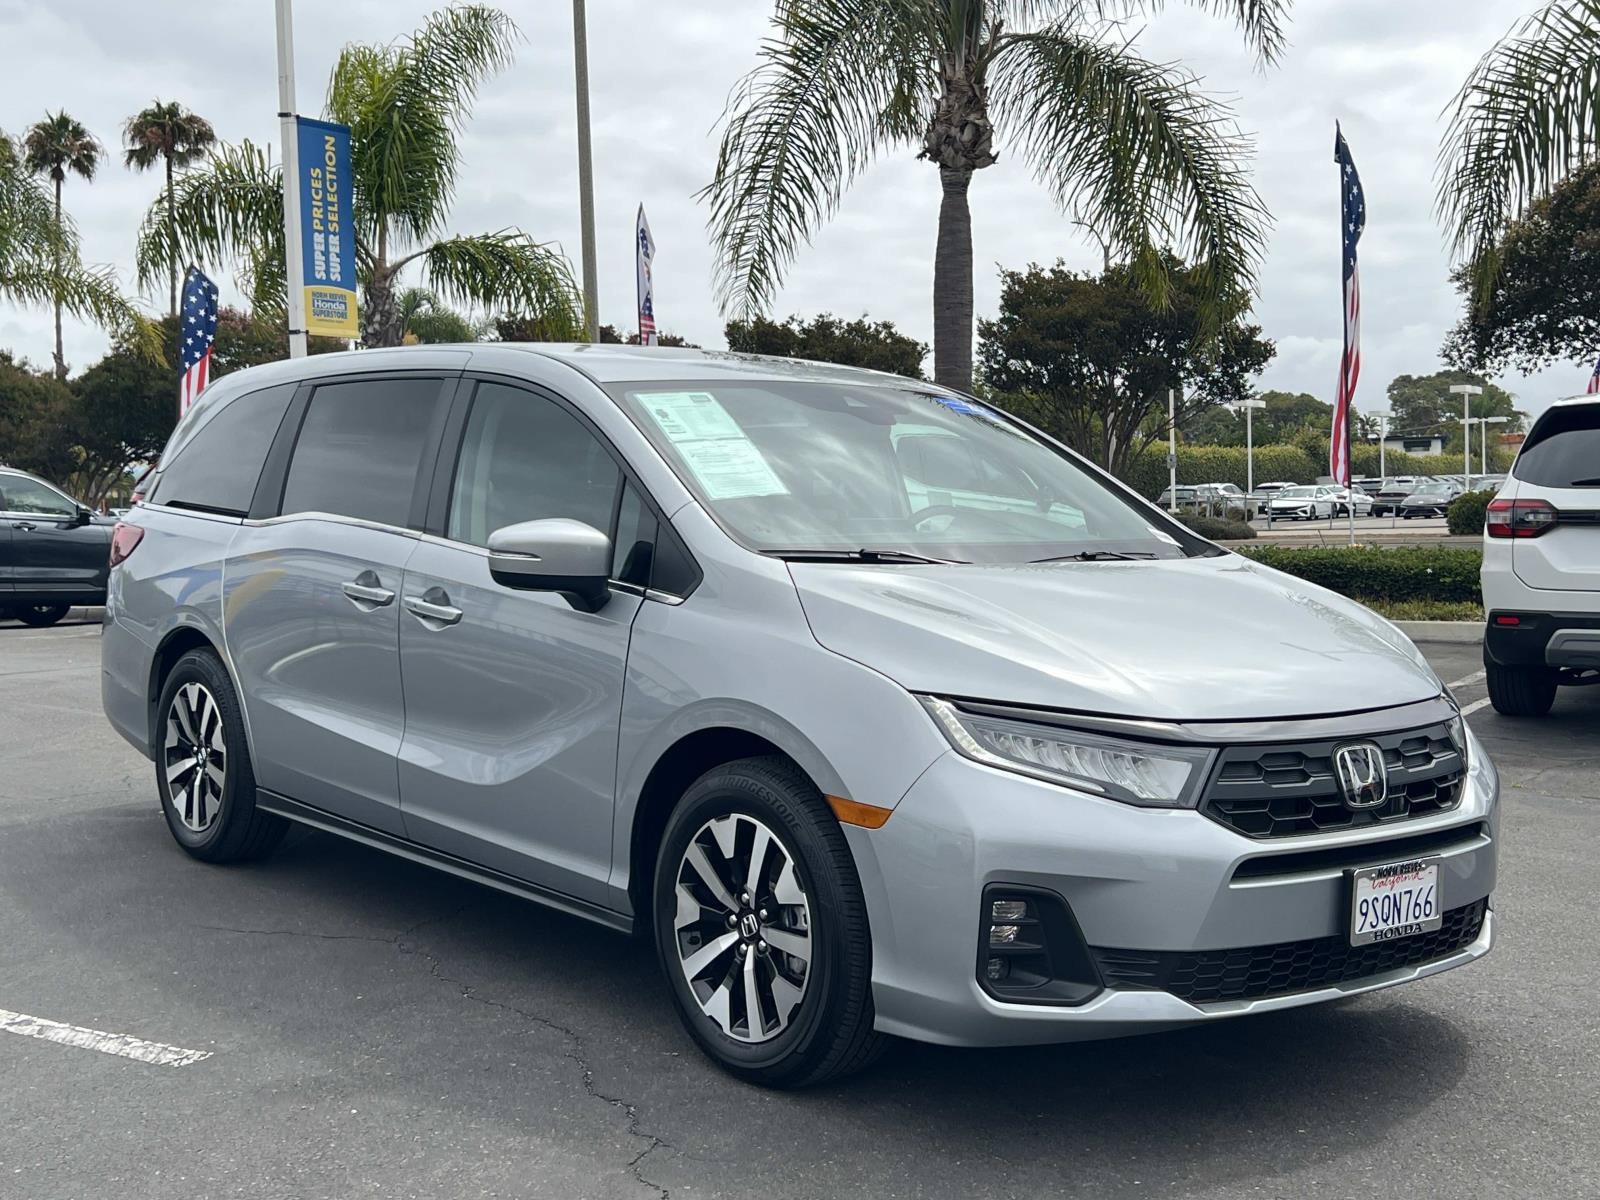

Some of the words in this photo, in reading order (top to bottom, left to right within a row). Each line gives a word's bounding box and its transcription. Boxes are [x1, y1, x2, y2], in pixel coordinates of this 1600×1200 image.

[311, 168, 324, 230] PRICES
[324, 135, 340, 232] SELECTION
[314, 232, 326, 281] SUPER
[327, 233, 341, 283] SUPER
[312, 309, 348, 320] SUPERSTORE
[314, 299, 346, 310] Honda
[1370, 873, 1424, 891] California
[1358, 885, 1434, 932] 9SQN766
[1373, 923, 1422, 941] HONDA
